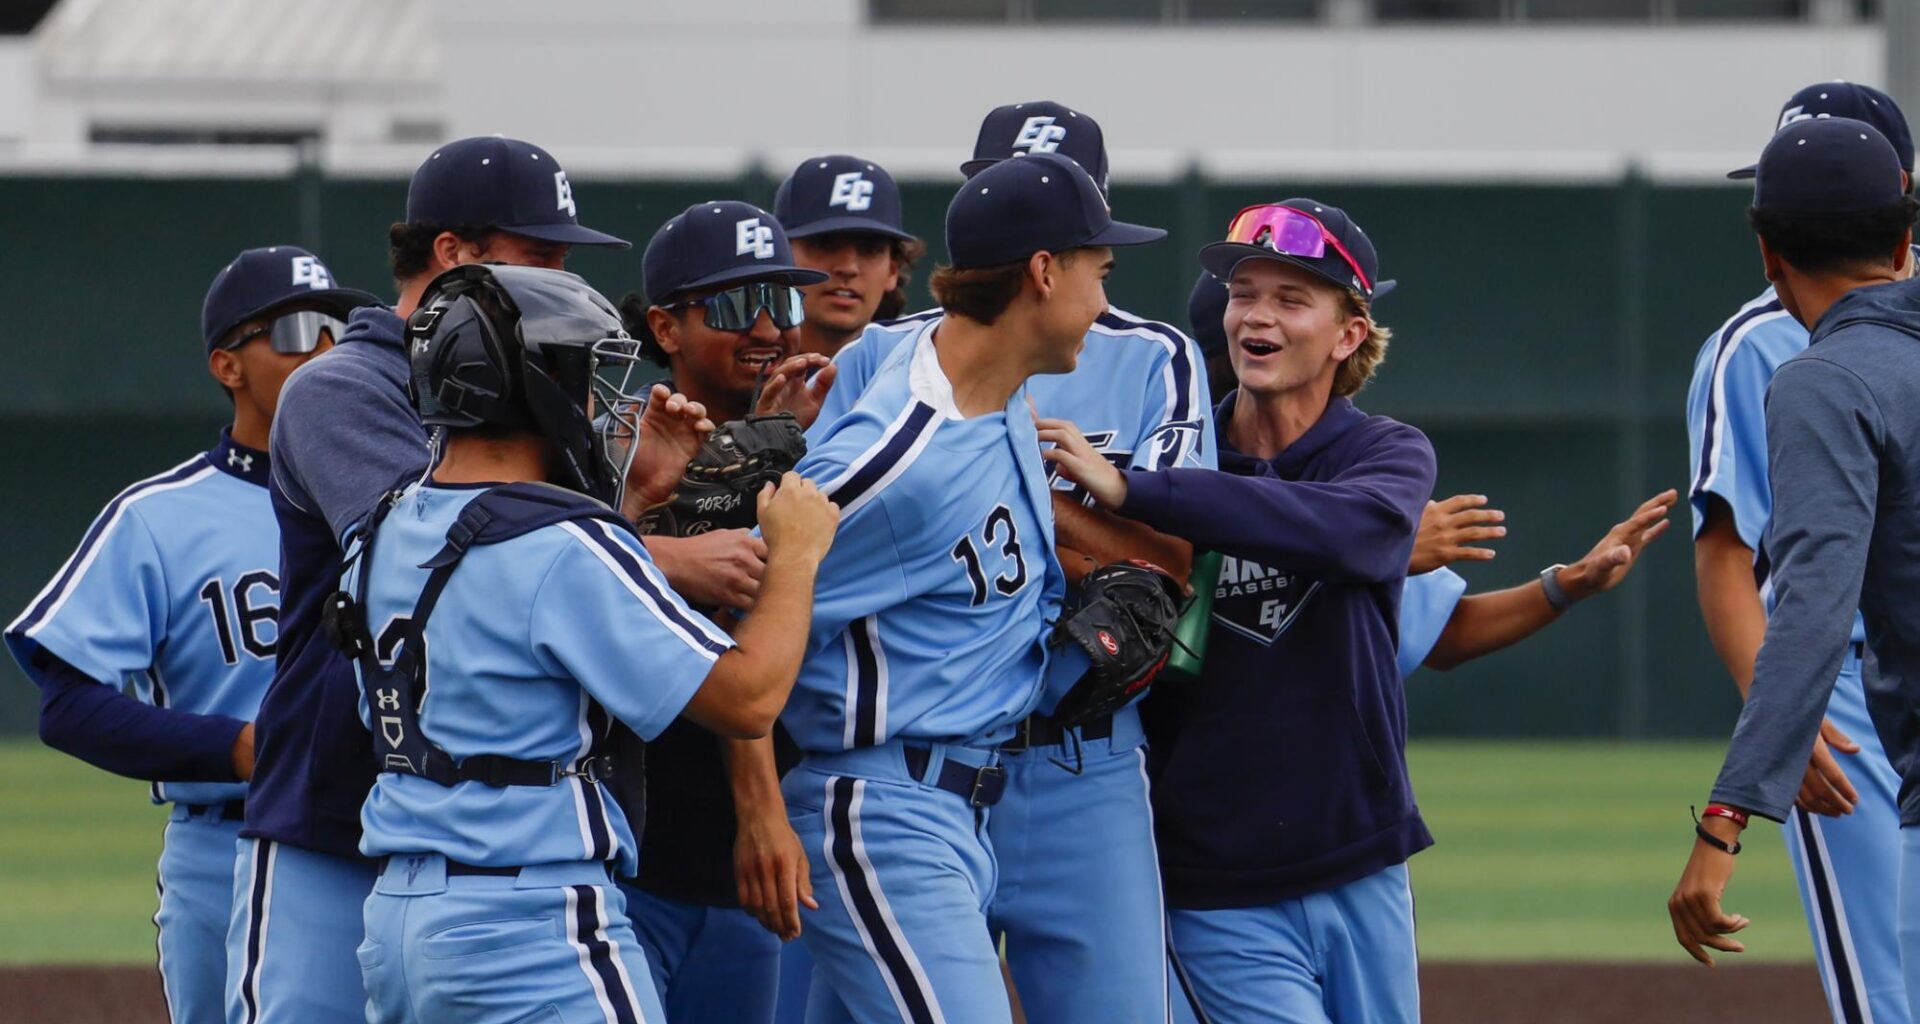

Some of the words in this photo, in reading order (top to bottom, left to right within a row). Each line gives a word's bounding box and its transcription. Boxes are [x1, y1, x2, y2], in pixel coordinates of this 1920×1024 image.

[1012, 116, 1066, 154] EC
[829, 172, 874, 211] EC
[736, 217, 775, 259] EC
[292, 256, 329, 290] EC
[950, 502, 1028, 608] 13
[1215, 575, 1296, 599] BASEB
[199, 568, 280, 666] 16
